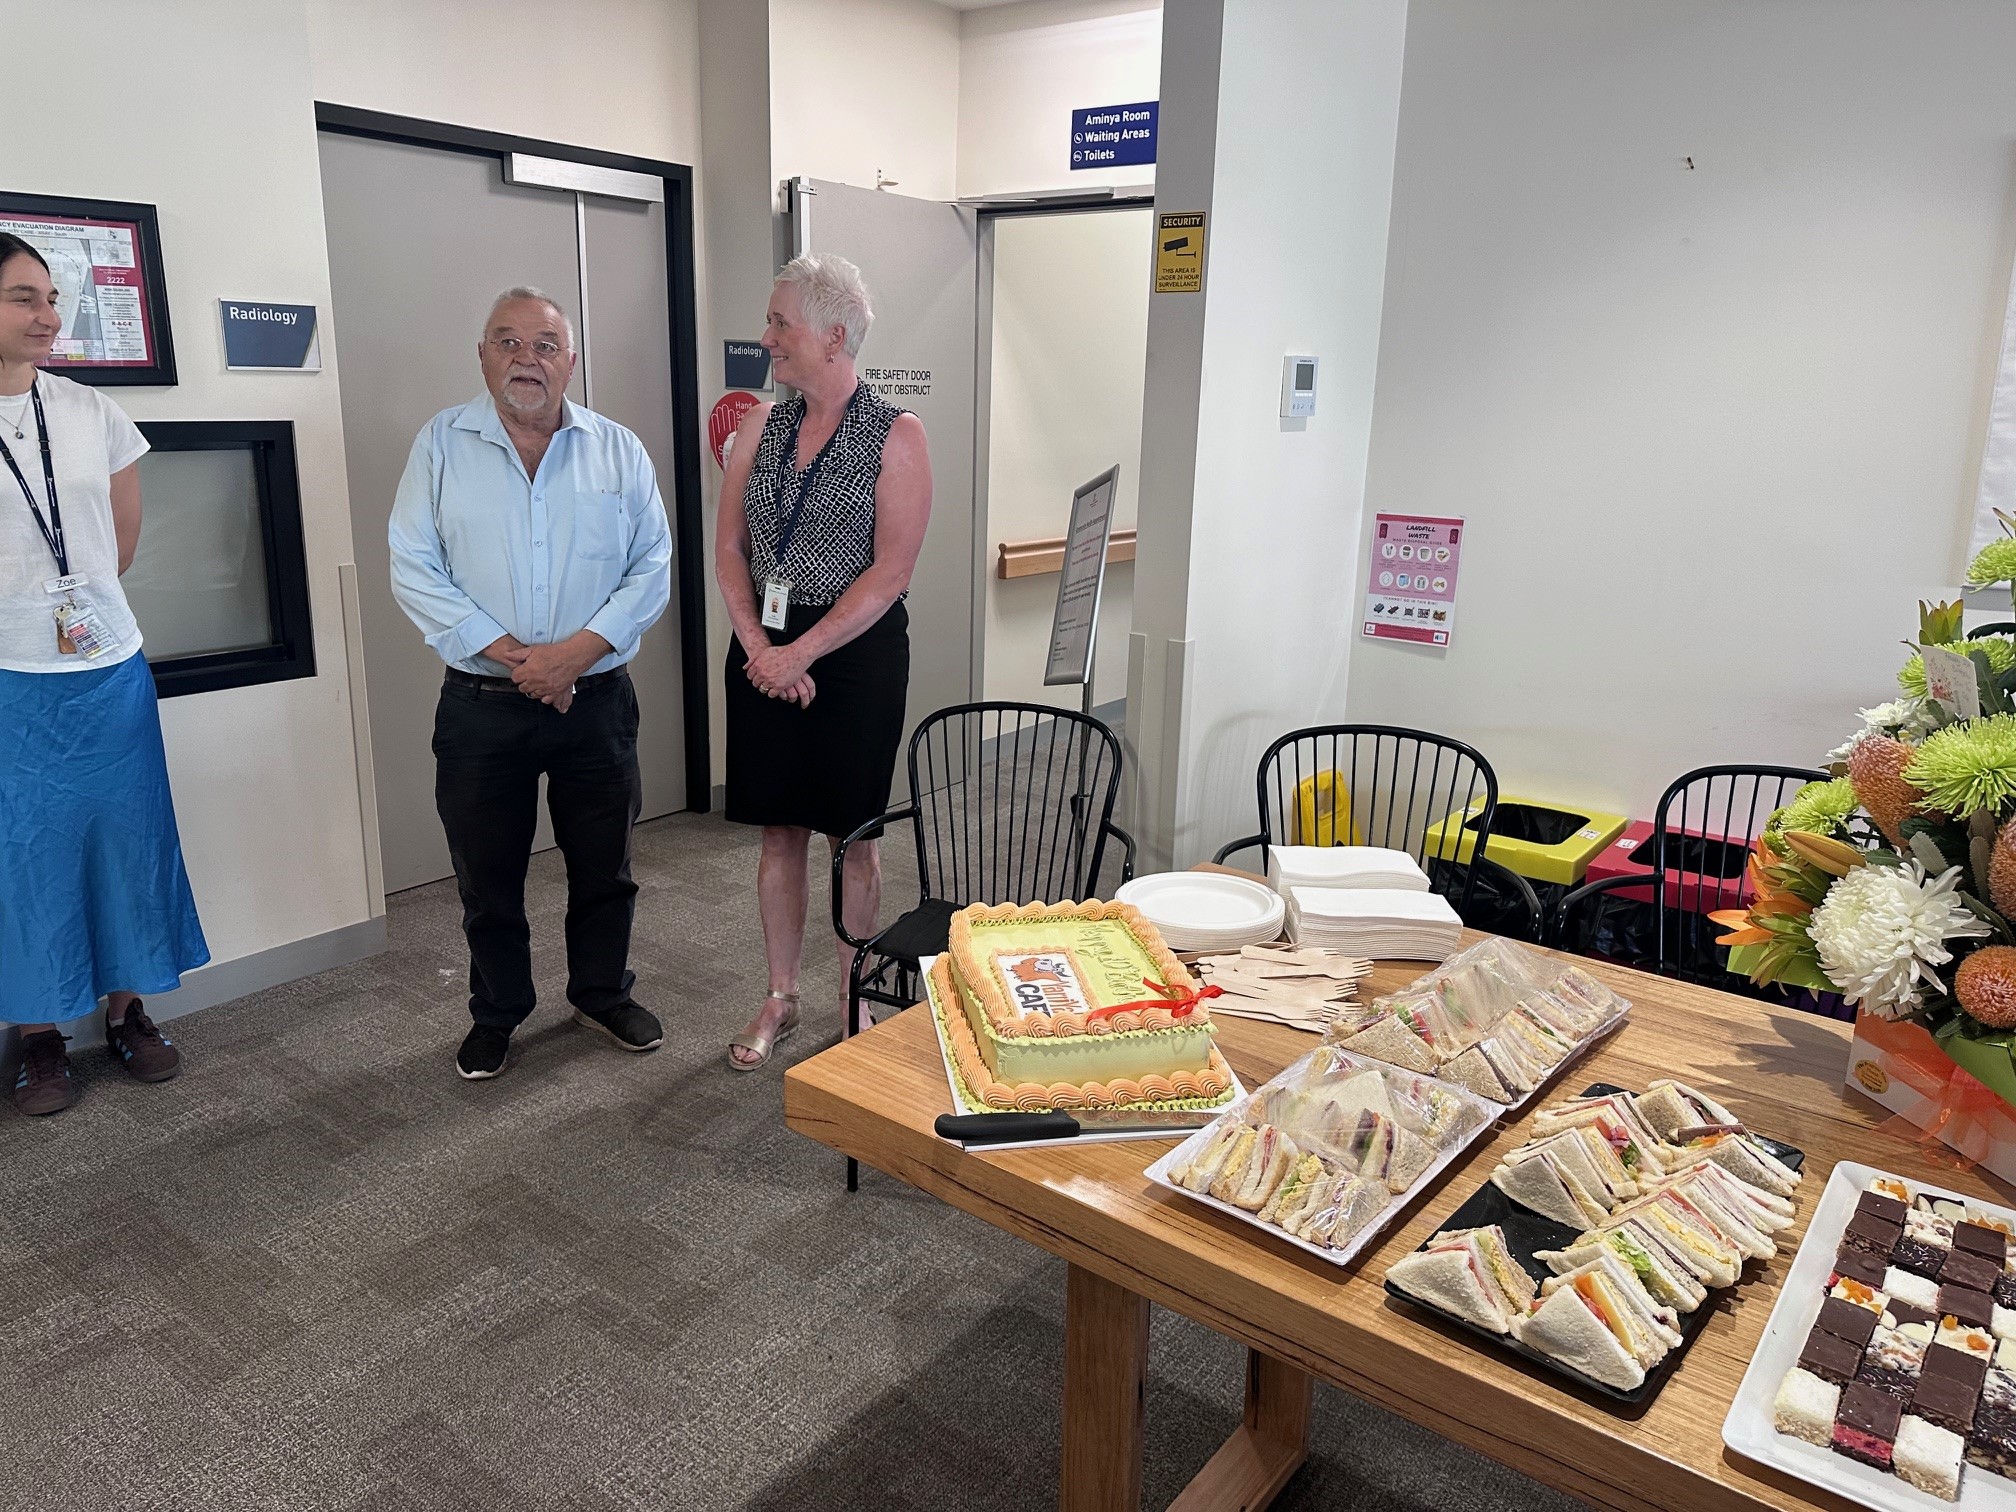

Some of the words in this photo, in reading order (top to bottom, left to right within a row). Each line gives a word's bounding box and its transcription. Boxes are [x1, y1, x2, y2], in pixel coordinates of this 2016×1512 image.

[1085, 113, 1120, 126] Aminya
[1122, 111, 1150, 122] Room
[1084, 130, 1120, 143] Waiting
[1121, 128, 1150, 140] Areas
[1083, 149, 1115, 161] Toilets
[12, 222, 54, 231] EVACUATION
[1163, 217, 1201, 227] SECURITY
[106, 276, 126, 284] 2222
[229, 306, 298, 325] Radiology
[728, 345, 763, 358] Radiology
[865, 368, 881, 380] FIRE
[882, 369, 909, 380] SAFETY
[911, 370, 931, 381] DOOR
[878, 384, 893, 395] NOT
[894, 384, 931, 396] OBSTRUCT
[735, 400, 752, 410] Hand
[1406, 525, 1436, 533] LANDFILL
[55, 578, 77, 589] Zoe
